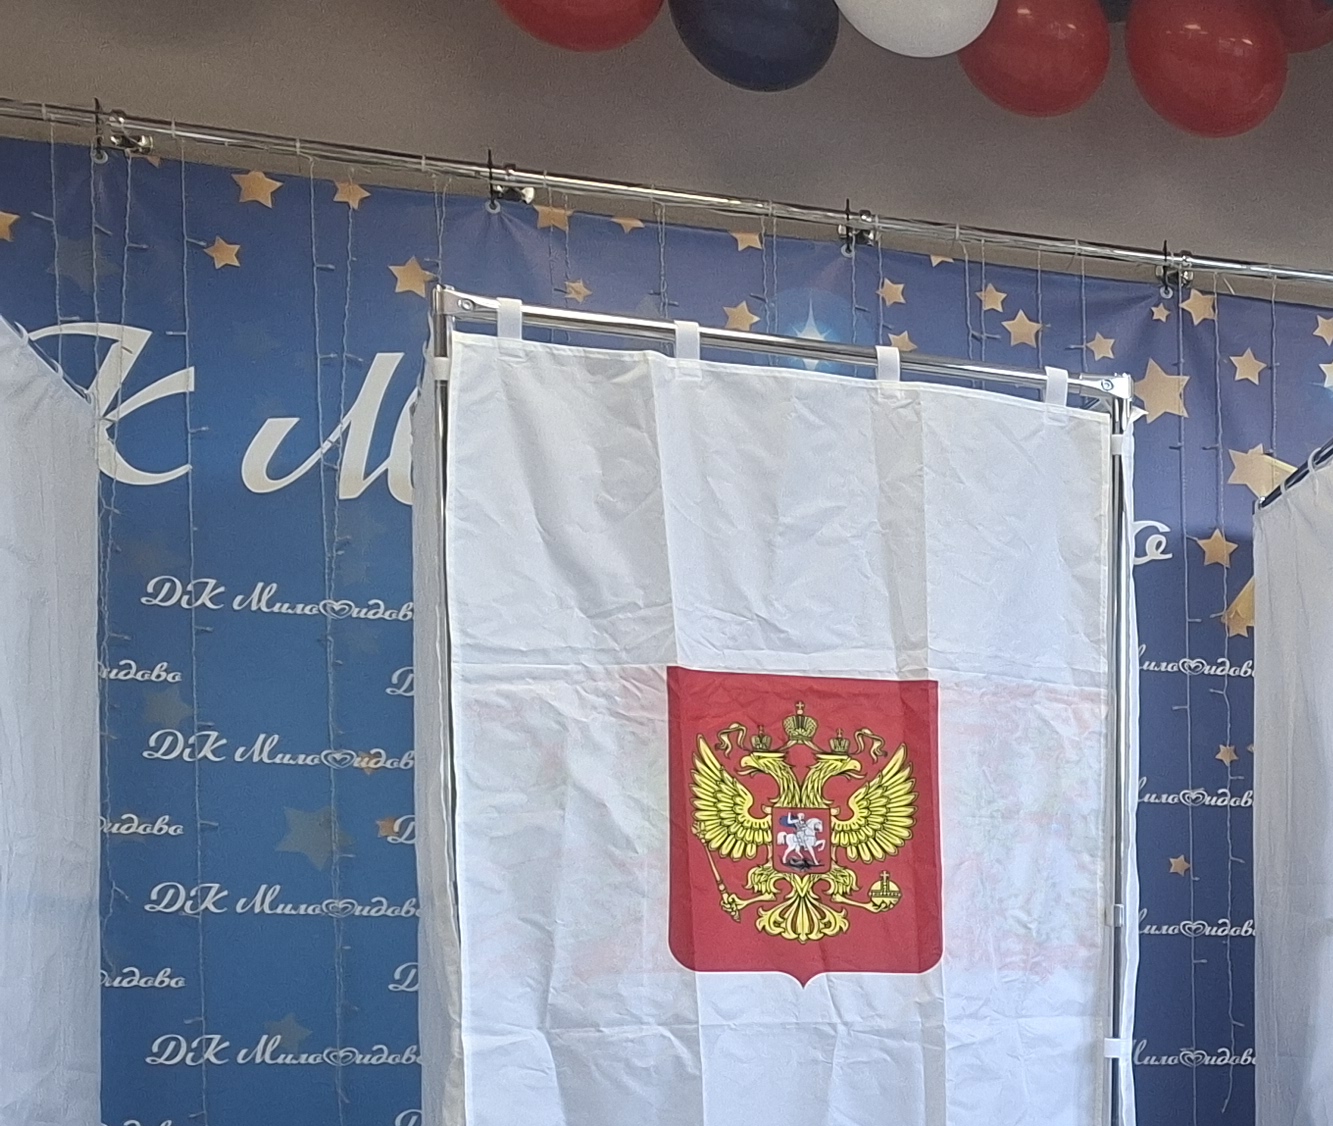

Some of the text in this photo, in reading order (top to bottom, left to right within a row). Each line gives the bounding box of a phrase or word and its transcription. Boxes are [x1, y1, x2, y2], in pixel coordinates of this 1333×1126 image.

[141, 575, 225, 610] ДК
[142, 729, 227, 762] ДК
[144, 882, 228, 914] ДК
[145, 1034, 230, 1066] ДК
